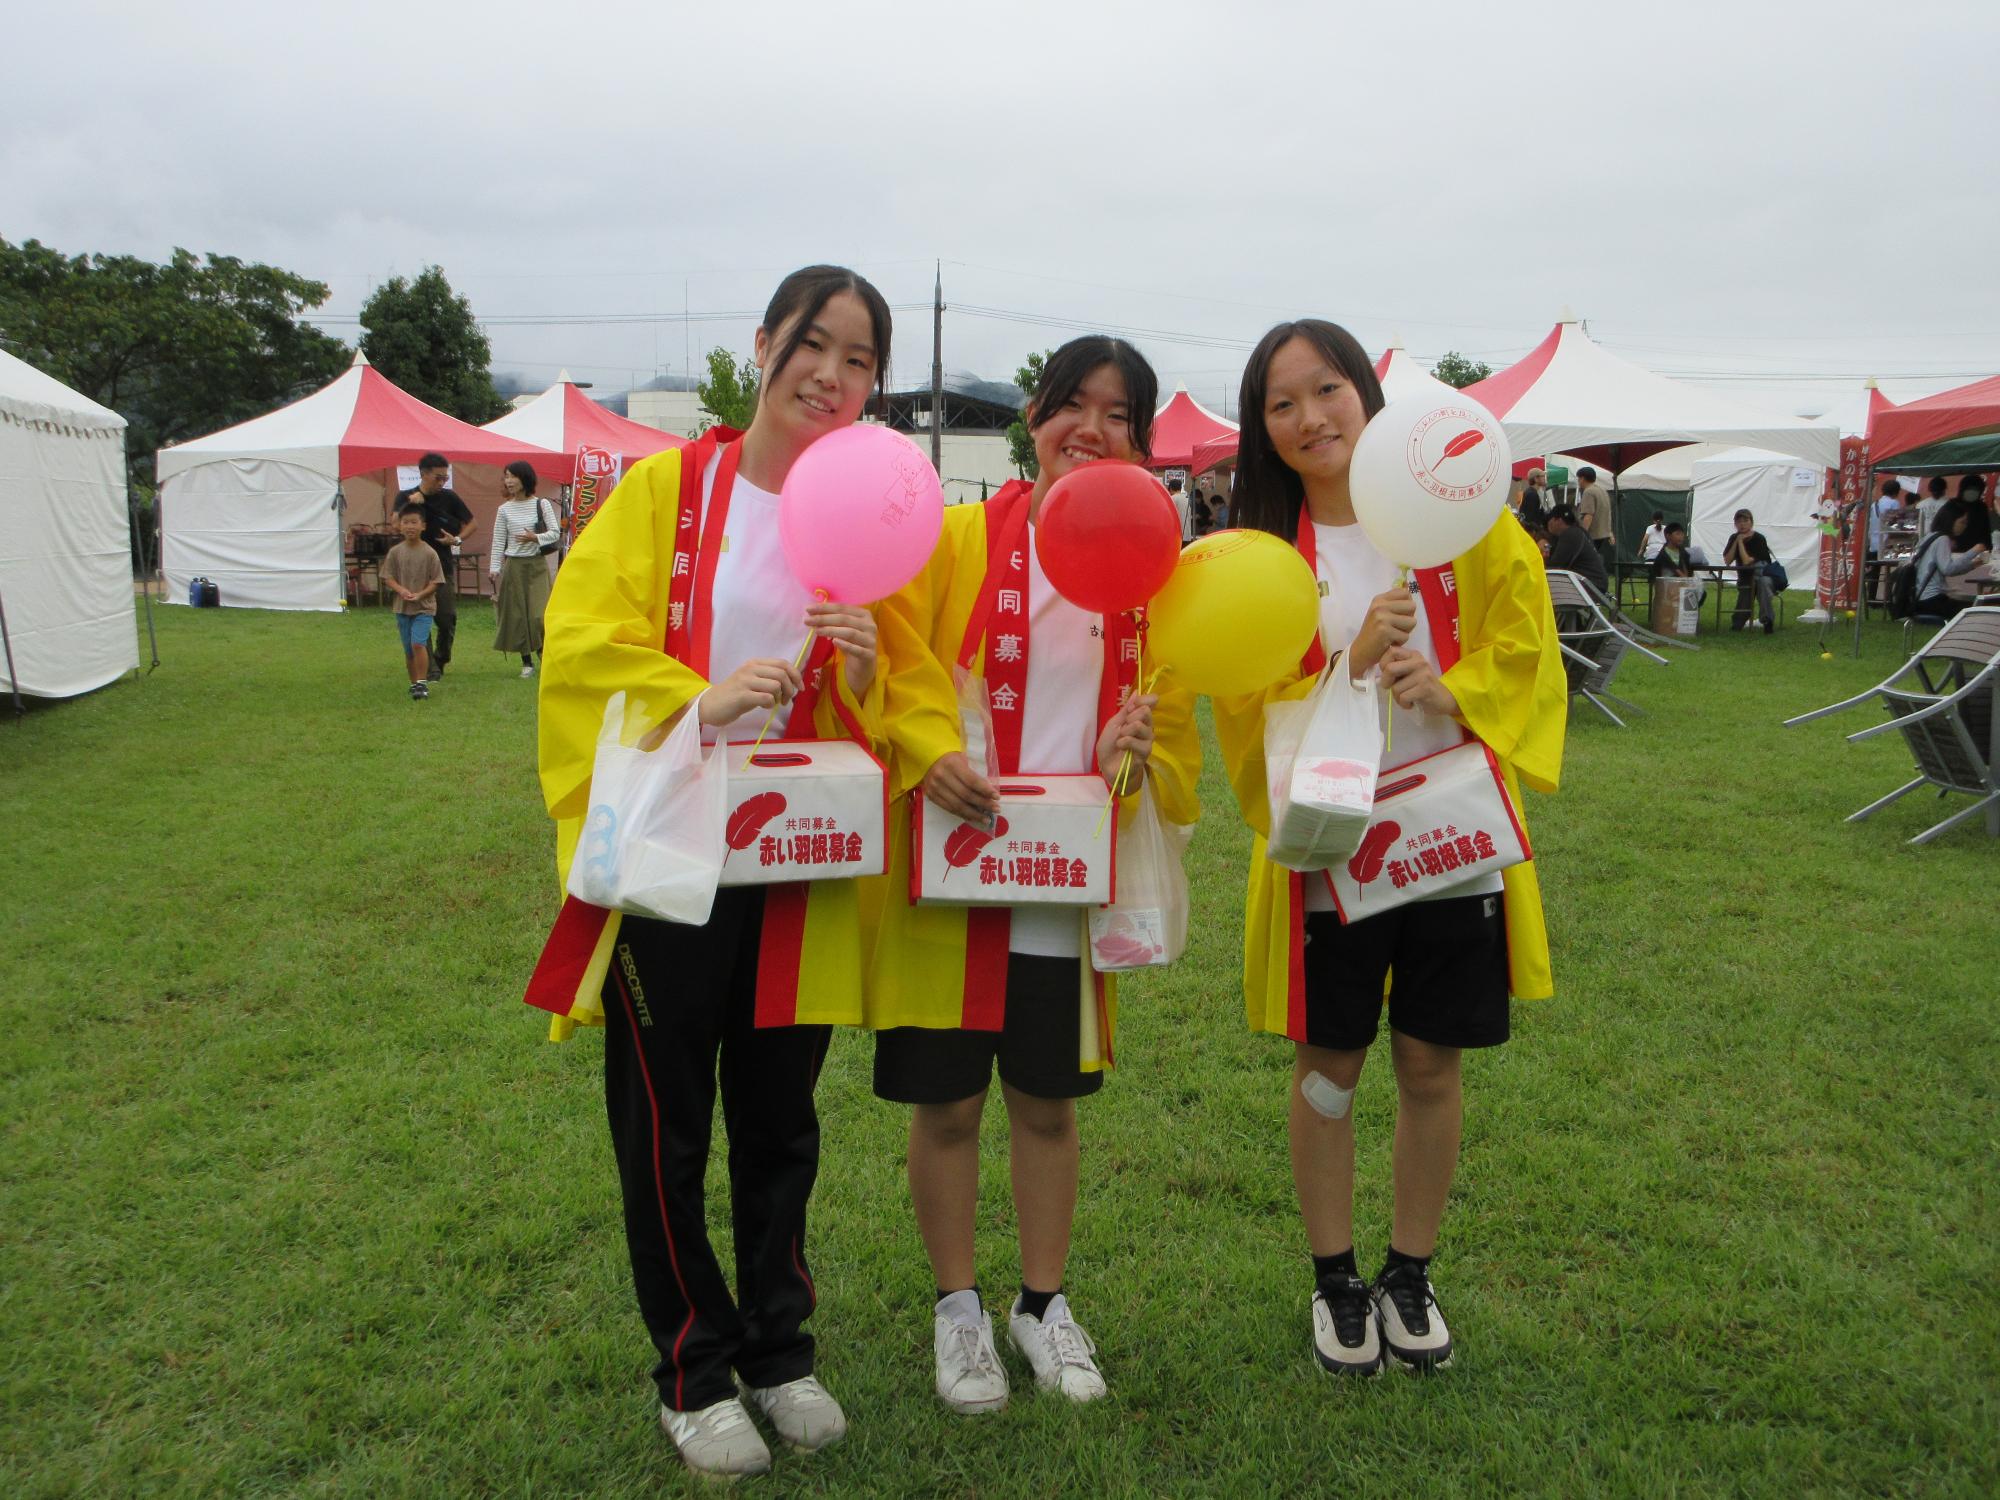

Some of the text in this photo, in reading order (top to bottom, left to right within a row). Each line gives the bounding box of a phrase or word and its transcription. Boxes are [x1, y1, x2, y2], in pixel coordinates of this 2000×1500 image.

[786, 816, 837, 831] 共同募金
[1406, 824, 1459, 851] 共同募金
[759, 831, 863, 867] 赤い羽根募金
[1007, 840, 1061, 855] 共同募金
[1387, 829, 1498, 889] 赤い羽根募金
[979, 854, 1088, 888] 赤い羽根募金
[618, 943, 654, 1028] DESCENTE
